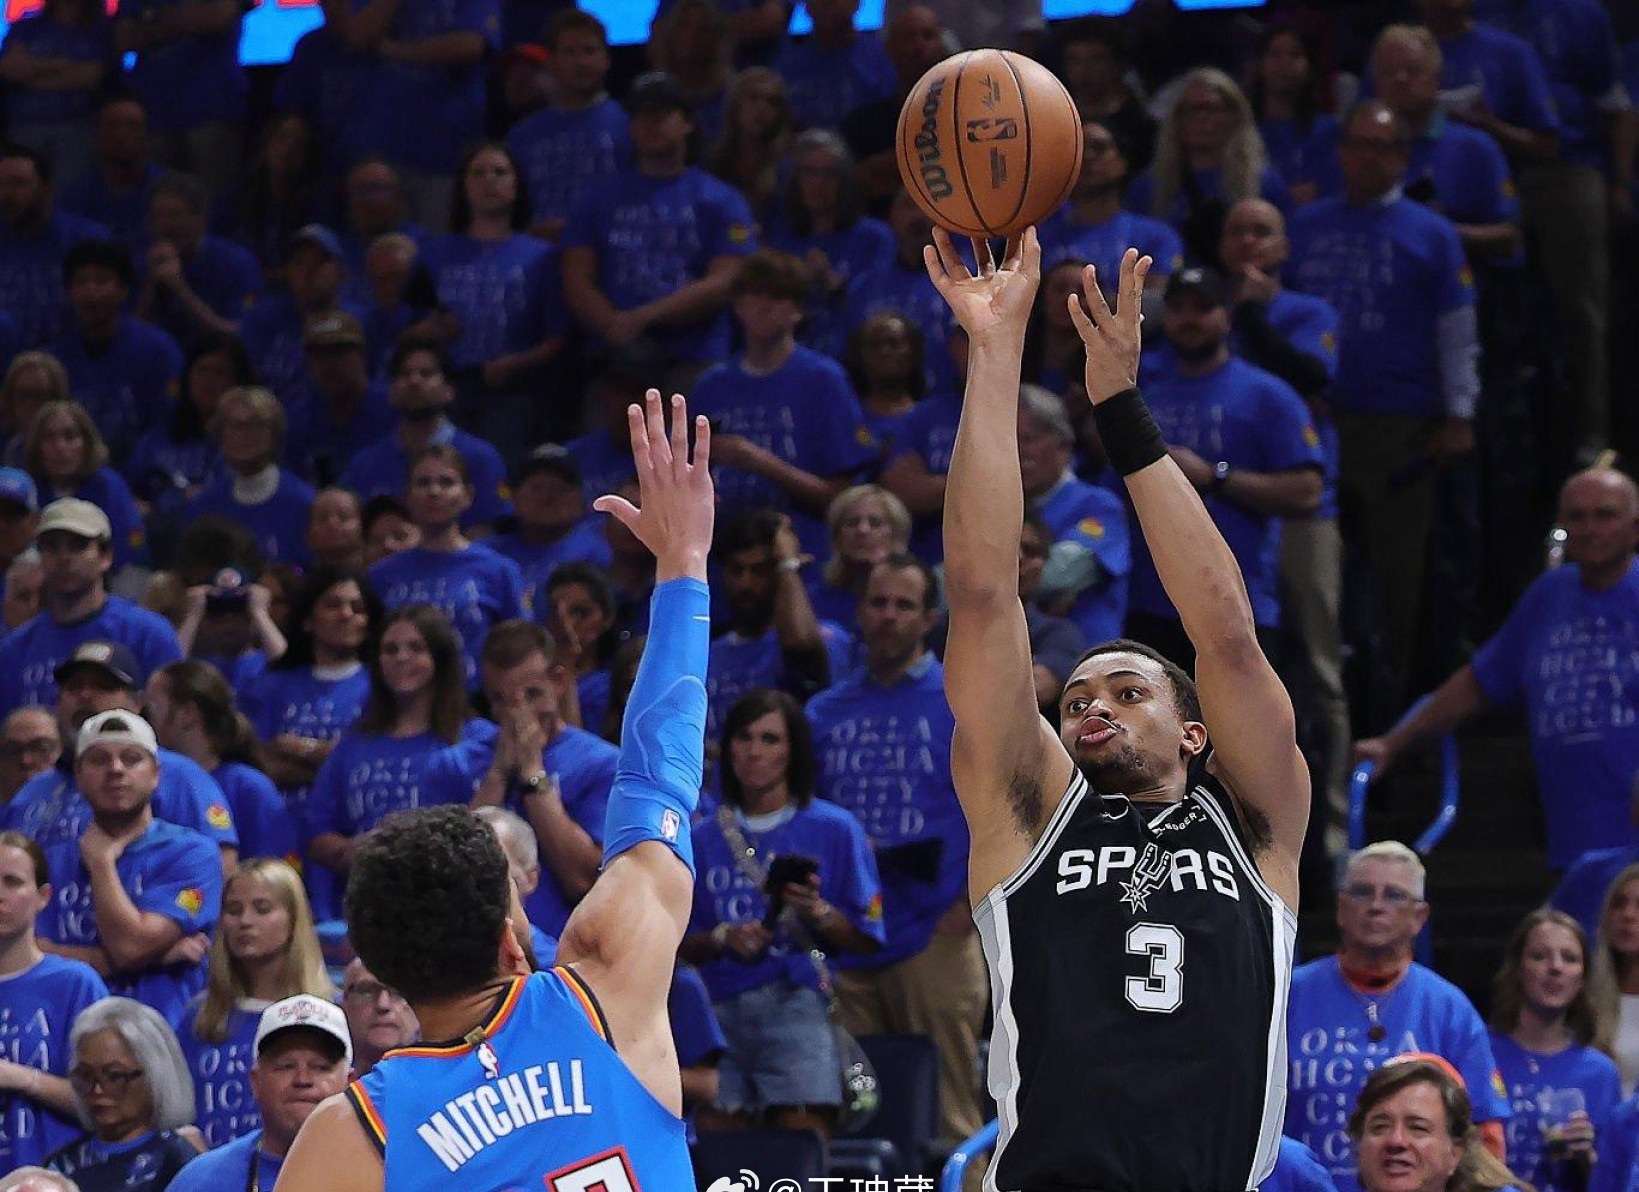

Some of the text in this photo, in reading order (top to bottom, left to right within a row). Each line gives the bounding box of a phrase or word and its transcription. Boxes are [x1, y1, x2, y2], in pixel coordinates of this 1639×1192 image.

[915, 76, 953, 201] Wilson
[1056, 842, 1241, 915] SPURS
[1124, 921, 1185, 1014] 3
[416, 1058, 593, 1173] MITCHELL
